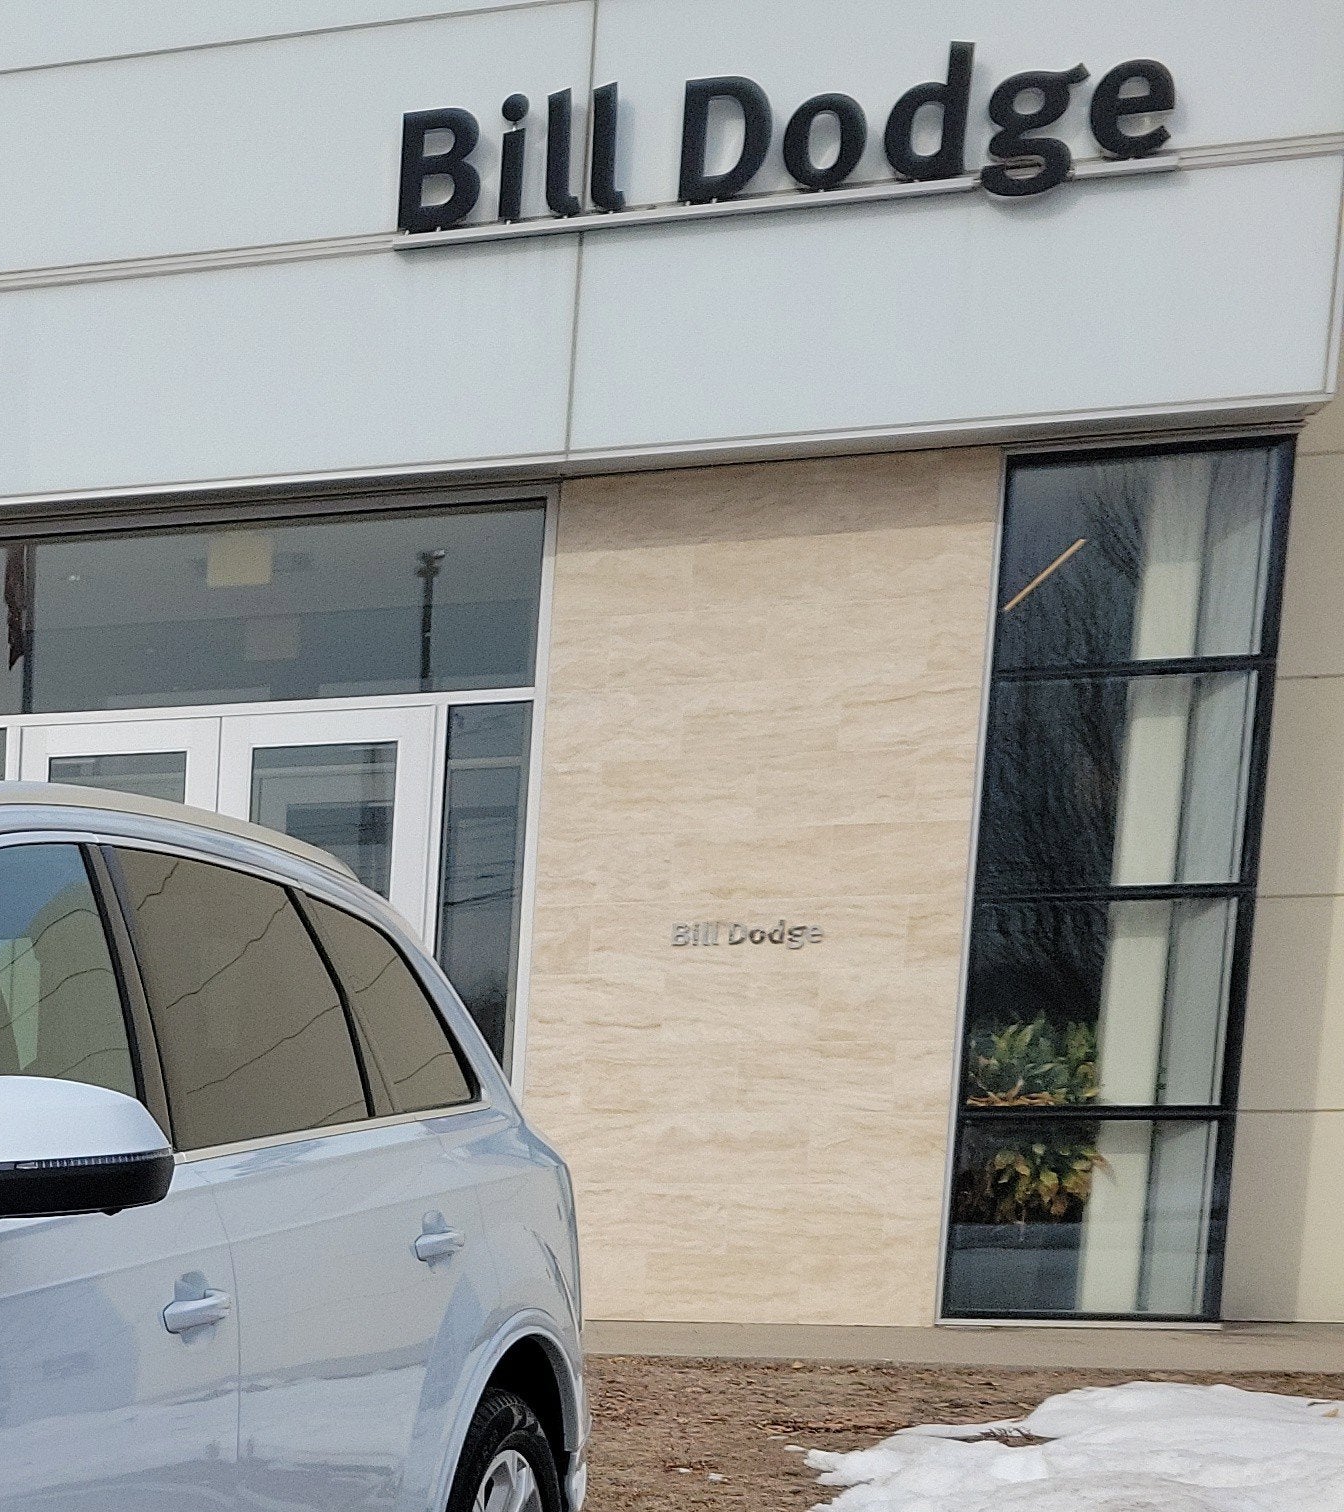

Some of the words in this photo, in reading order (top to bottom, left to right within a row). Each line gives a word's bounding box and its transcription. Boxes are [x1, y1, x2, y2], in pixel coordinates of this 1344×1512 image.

[398, 81, 626, 233] Bill
[678, 40, 1175, 201] Dodge
[671, 921, 721, 947] Bill
[727, 919, 825, 950] Dodge
